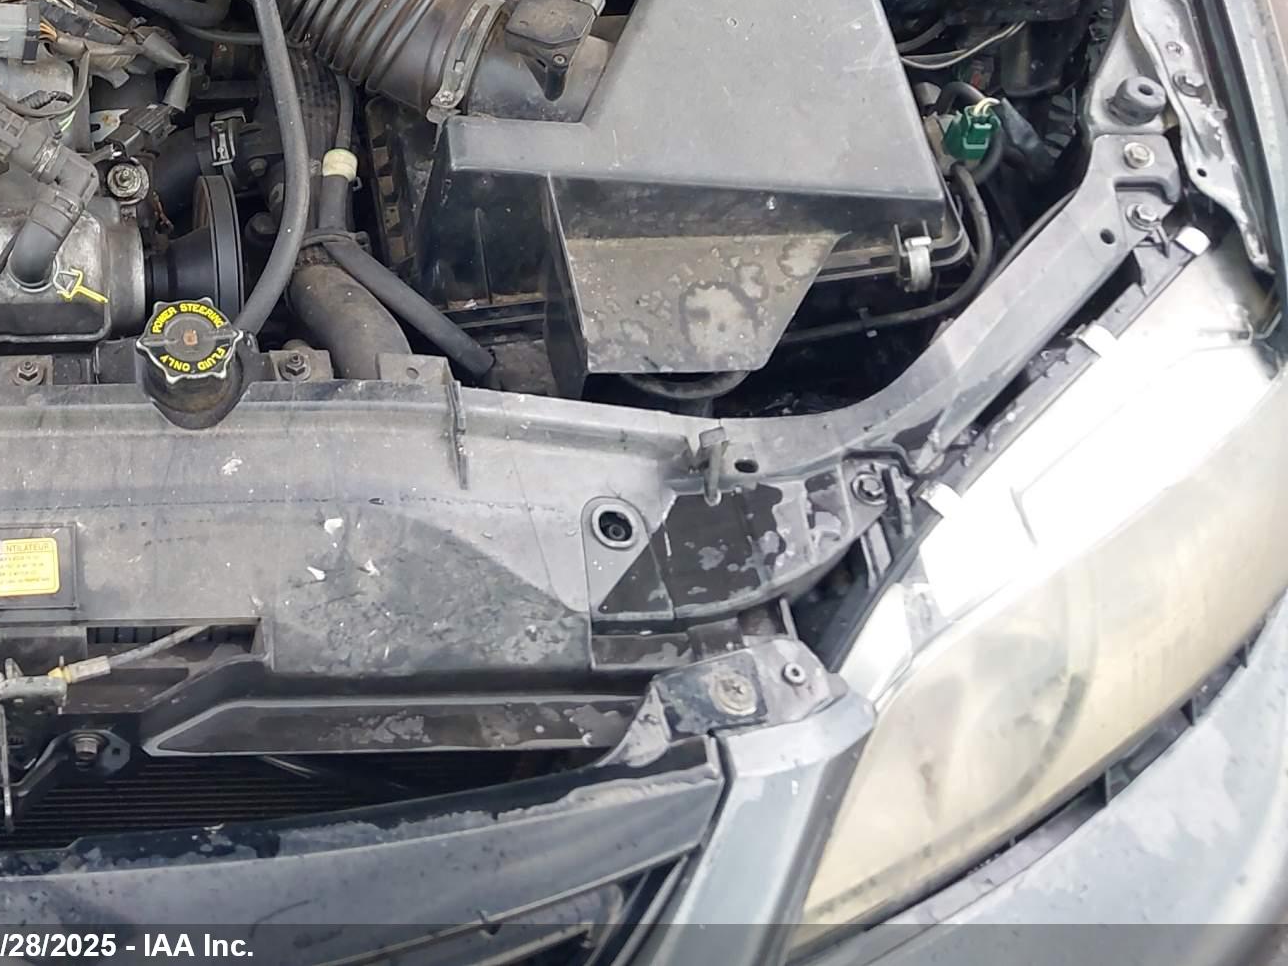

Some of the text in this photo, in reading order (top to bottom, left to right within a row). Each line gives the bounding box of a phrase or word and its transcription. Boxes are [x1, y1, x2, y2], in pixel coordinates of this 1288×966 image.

[152, 302, 226, 334] POWER STEERING
[159, 346, 227, 372] FLUID ONLY
